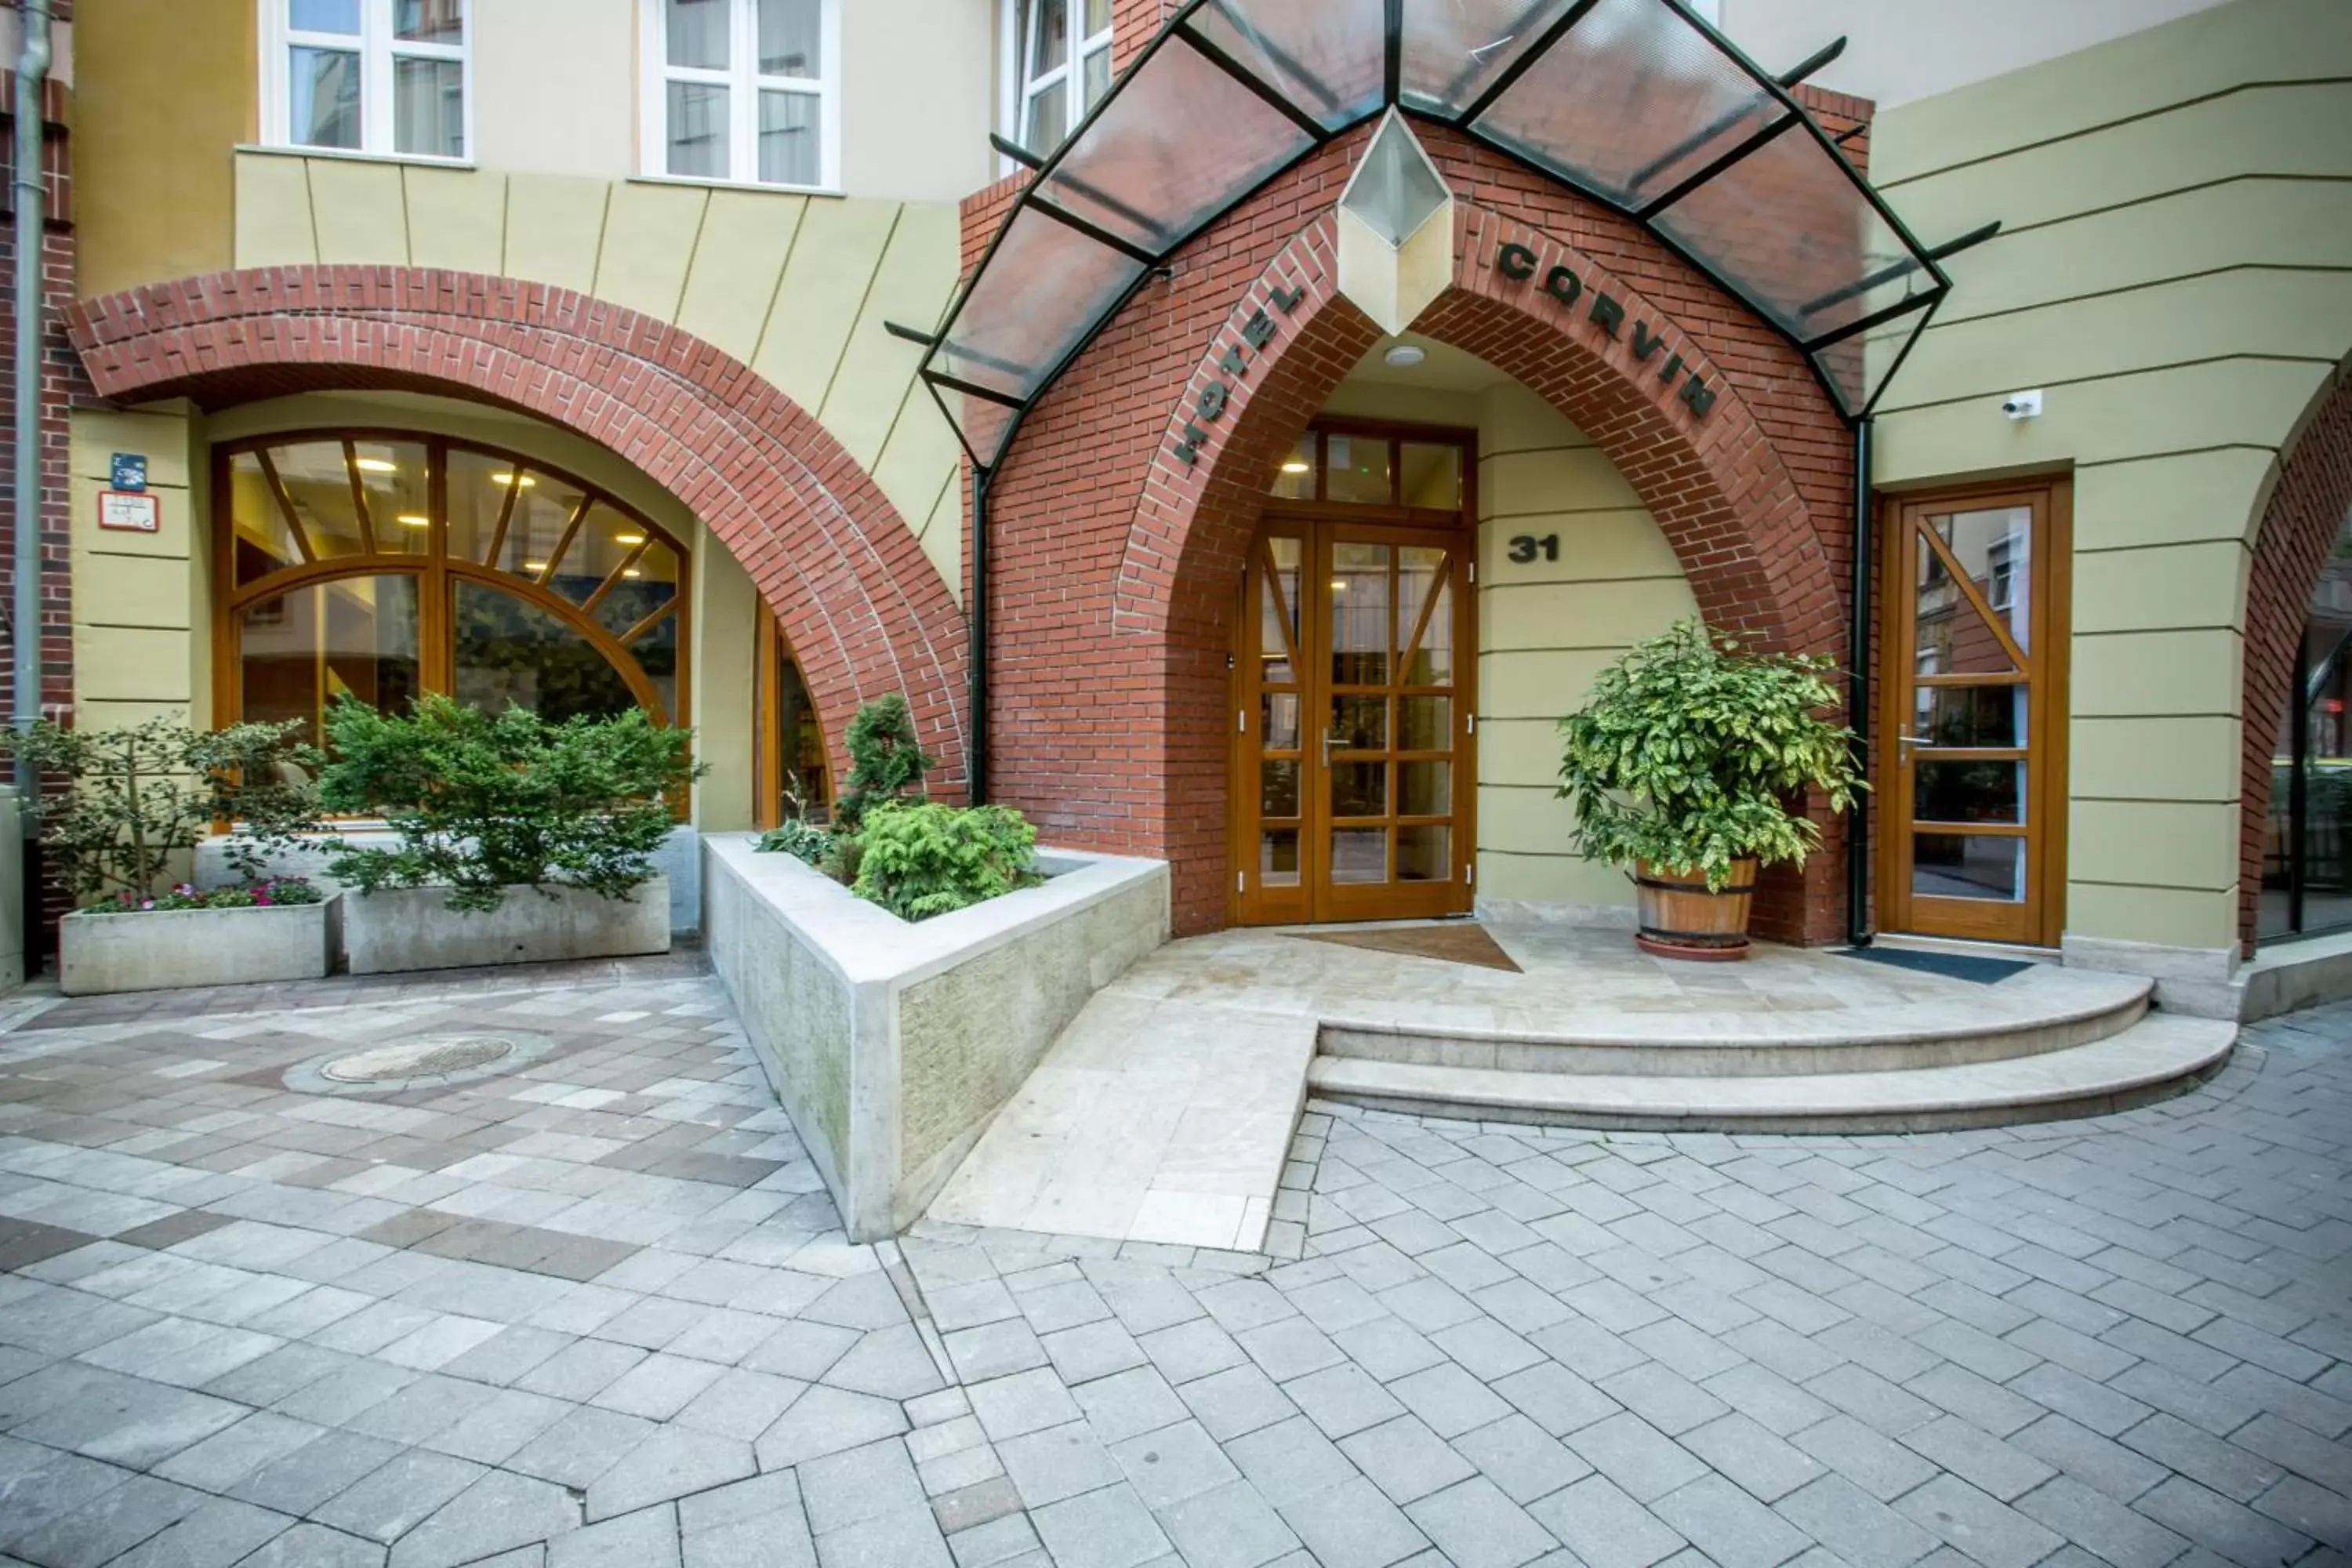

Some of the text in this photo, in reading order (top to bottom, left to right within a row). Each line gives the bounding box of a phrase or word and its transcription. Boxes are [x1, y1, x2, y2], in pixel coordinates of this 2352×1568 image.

[1173, 242, 1717, 466] HOTEL CORVIN
[1508, 534, 1560, 564] 31
